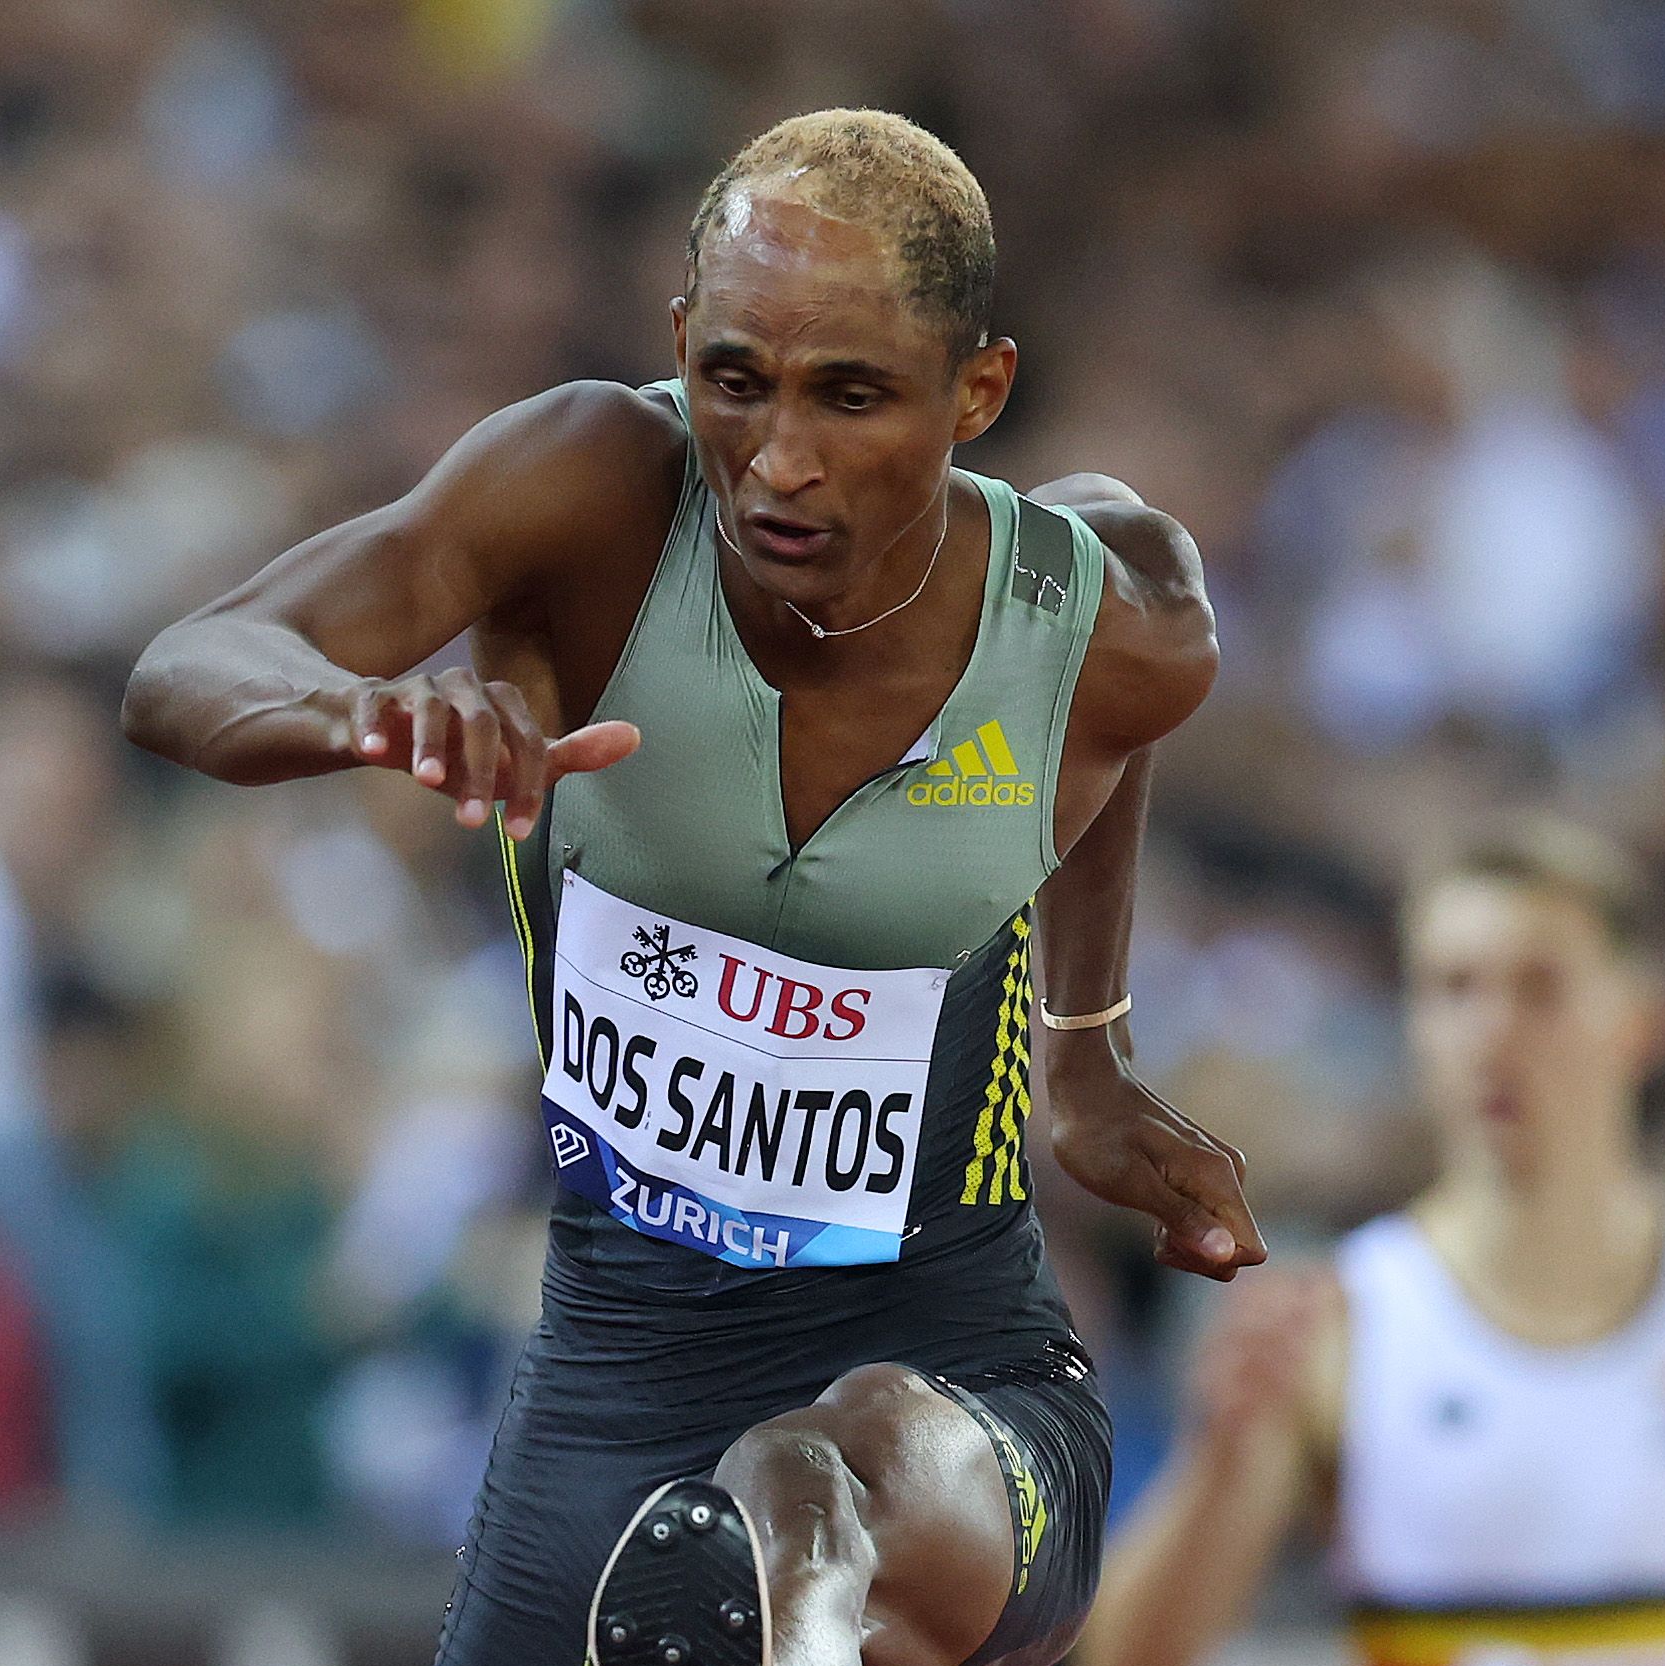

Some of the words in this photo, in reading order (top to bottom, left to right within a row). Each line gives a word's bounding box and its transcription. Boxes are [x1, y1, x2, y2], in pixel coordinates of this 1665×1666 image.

[906, 776, 1035, 806] adidas
[718, 954, 872, 1041] UBS
[563, 991, 657, 1130] DOS
[655, 1056, 913, 1194] SANTOS
[610, 1167, 791, 1268] ZURICH
